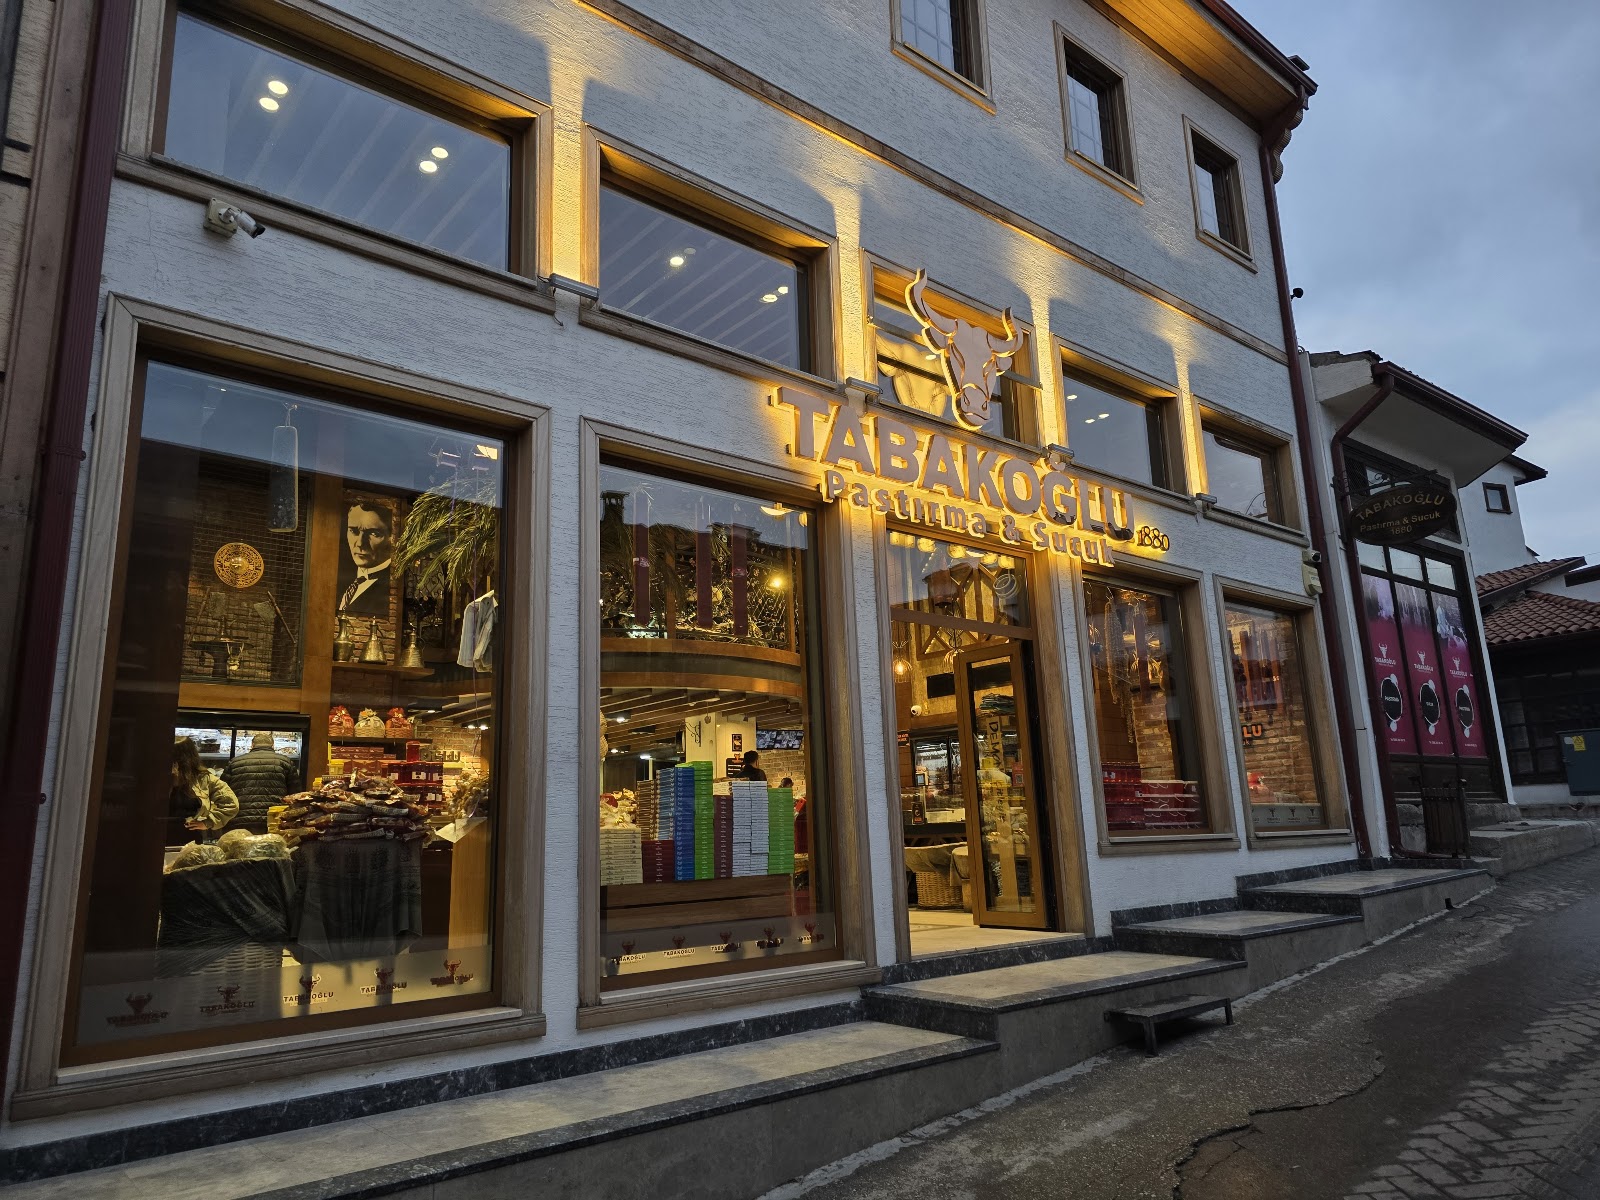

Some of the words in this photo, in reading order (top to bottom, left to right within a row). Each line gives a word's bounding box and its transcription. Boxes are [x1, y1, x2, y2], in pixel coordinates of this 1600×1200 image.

[772, 385, 1135, 542] TABAKOĞLU
[820, 469, 990, 538] Pastırma
[1000, 514, 1021, 545] &
[1031, 521, 1115, 568] Sucuk
[1355, 491, 1445, 521] TABAKOĞLU
[1402, 516, 1409, 525] &
[1411, 510, 1441, 523] Sucuk
[1137, 524, 1170, 553] 1880
[1390, 525, 1413, 536] 1880
